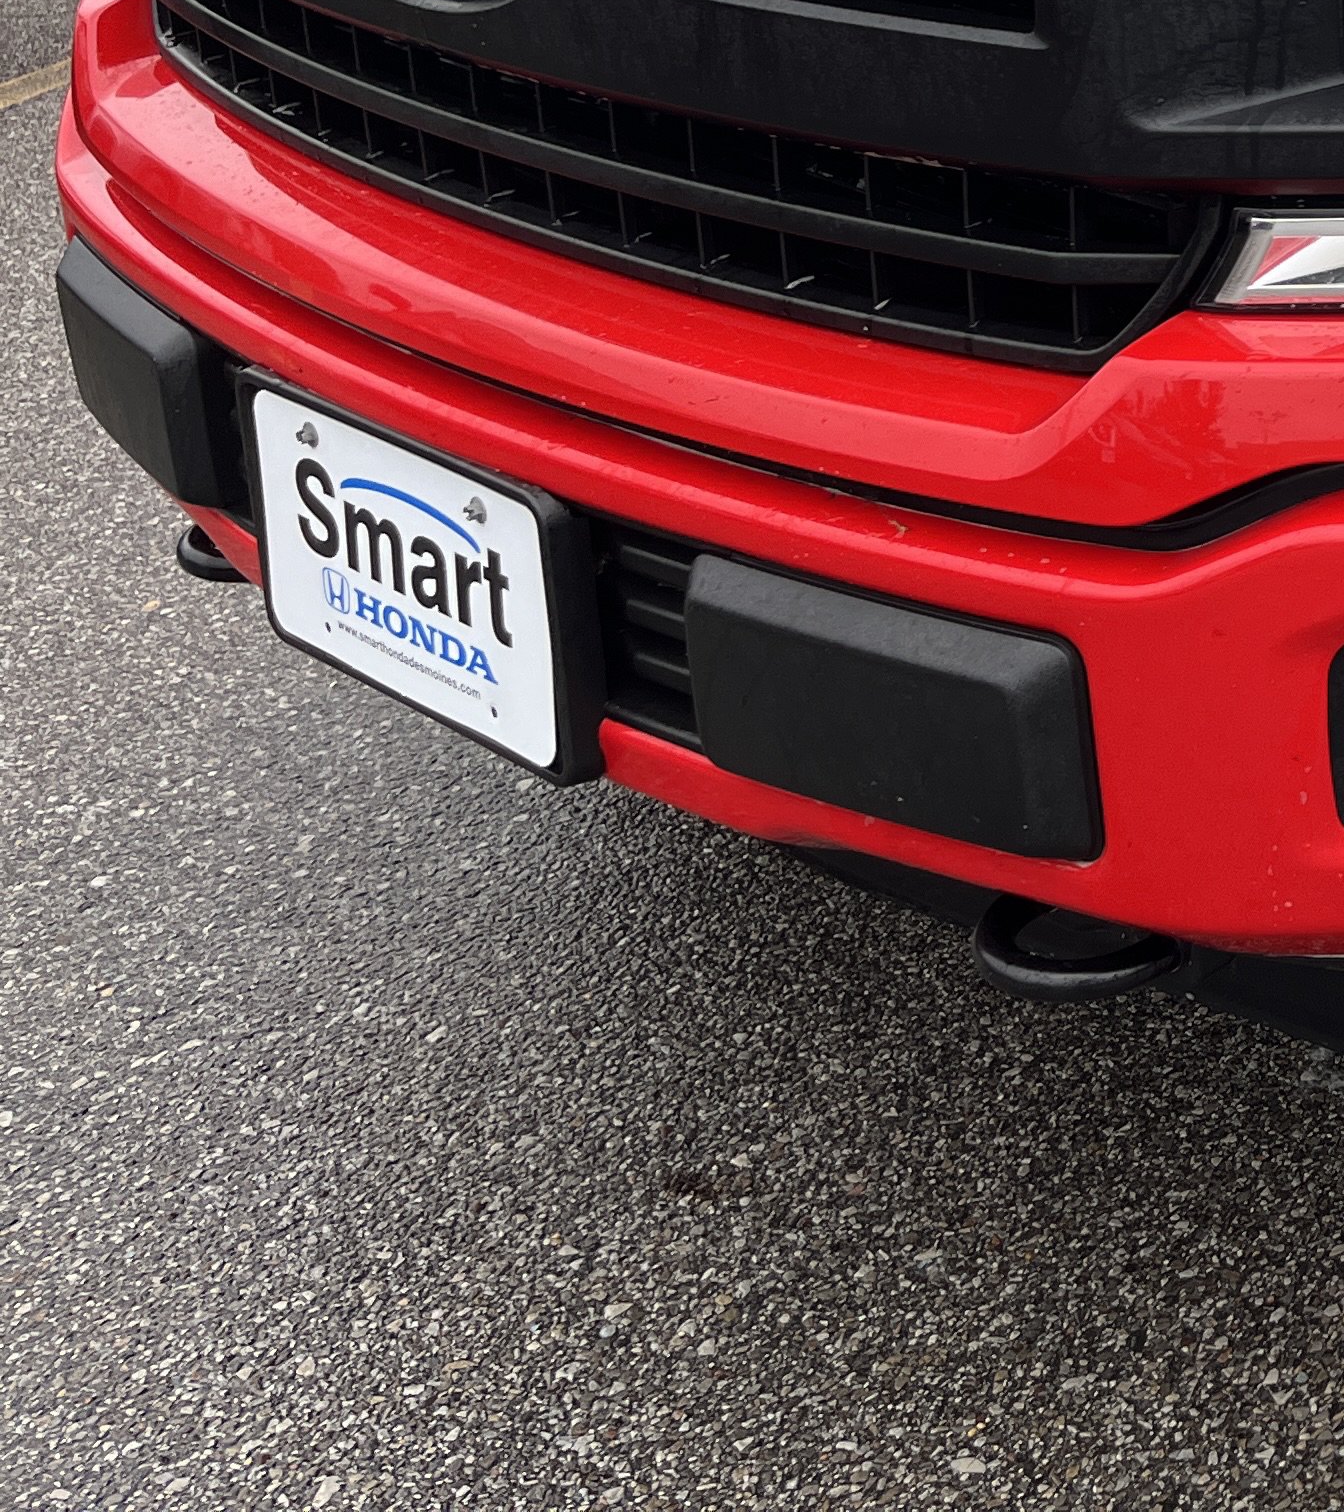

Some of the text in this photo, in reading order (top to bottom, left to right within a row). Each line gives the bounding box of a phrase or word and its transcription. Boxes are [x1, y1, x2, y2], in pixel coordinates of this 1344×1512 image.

[295, 457, 514, 649] Smart
[337, 620, 483, 701] www.smarthondadesmoines.com
[354, 587, 499, 686] HONDA
